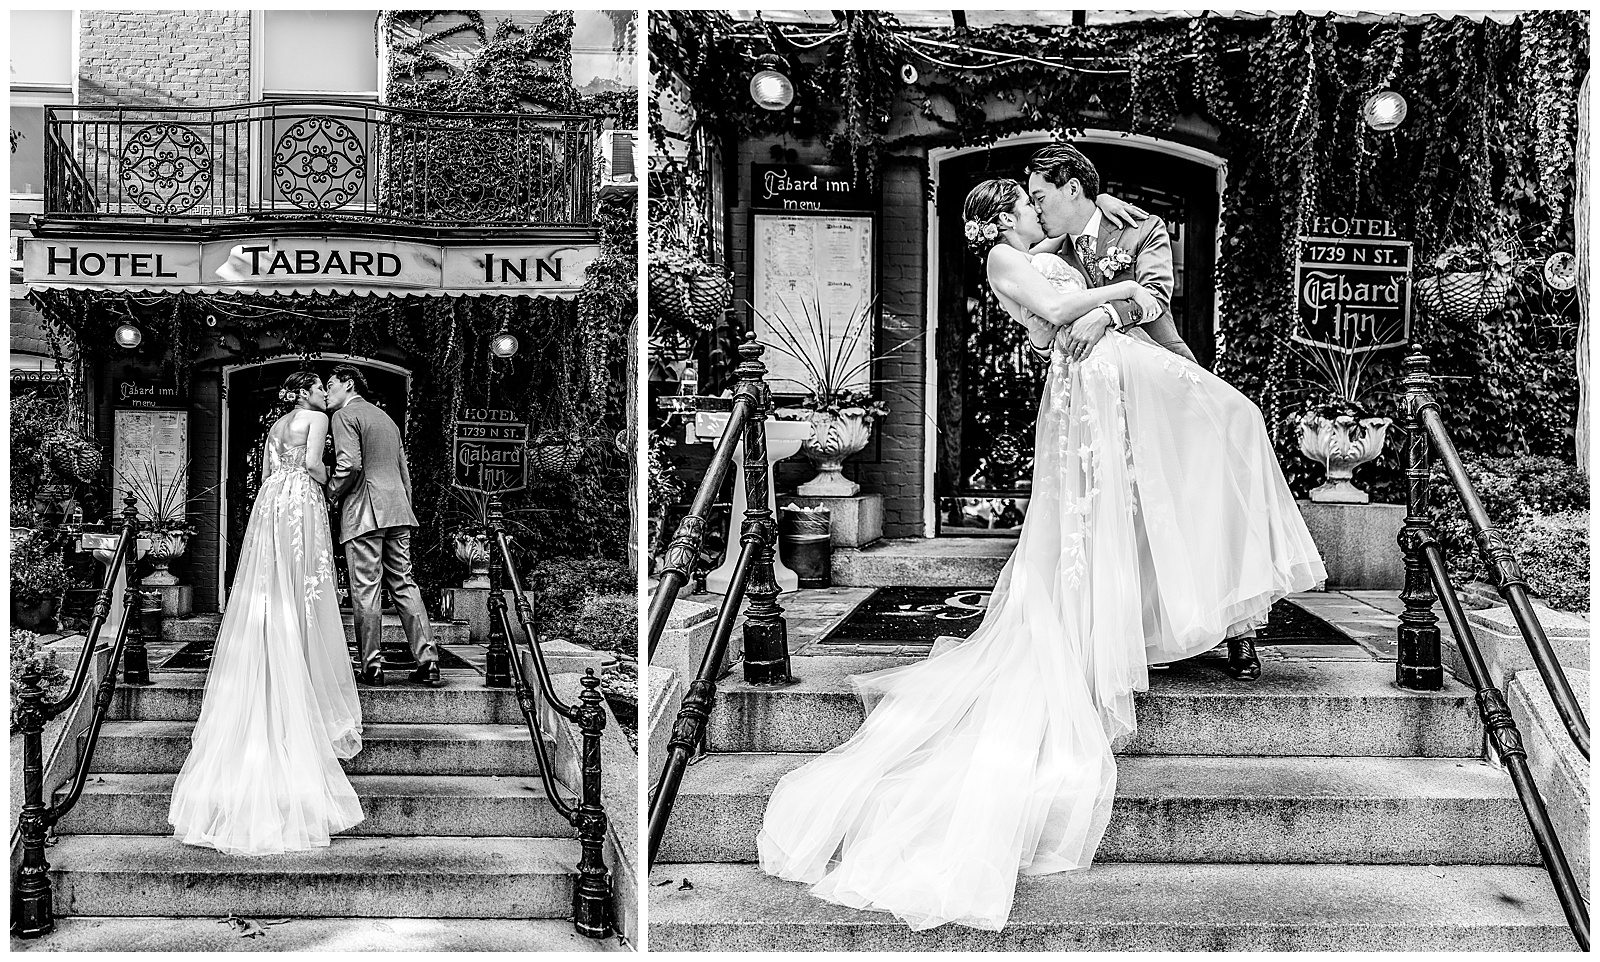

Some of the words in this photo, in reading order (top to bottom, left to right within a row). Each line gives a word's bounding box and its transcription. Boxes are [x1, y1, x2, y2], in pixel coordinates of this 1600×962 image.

[763, 168, 818, 200] Tabard
[783, 198, 821, 210] menu
[1312, 216, 1397, 237] HOTEL
[47, 246, 177, 278] HOTEL
[242, 244, 401, 277] TABARD
[484, 253, 563, 282] INN
[1309, 246, 1346, 261] 1739
[1353, 248, 1366, 262] N
[1373, 249, 1398, 264] ST.
[1303, 270, 1399, 325] Tabard
[1332, 302, 1380, 343] Inn
[464, 408, 519, 421] HOTEL
[462, 427, 486, 437] 1739
[490, 428, 499, 437] N
[503, 428, 519, 438] ST.
[459, 442, 520, 477] Tabard
[478, 462, 510, 489] Inn
